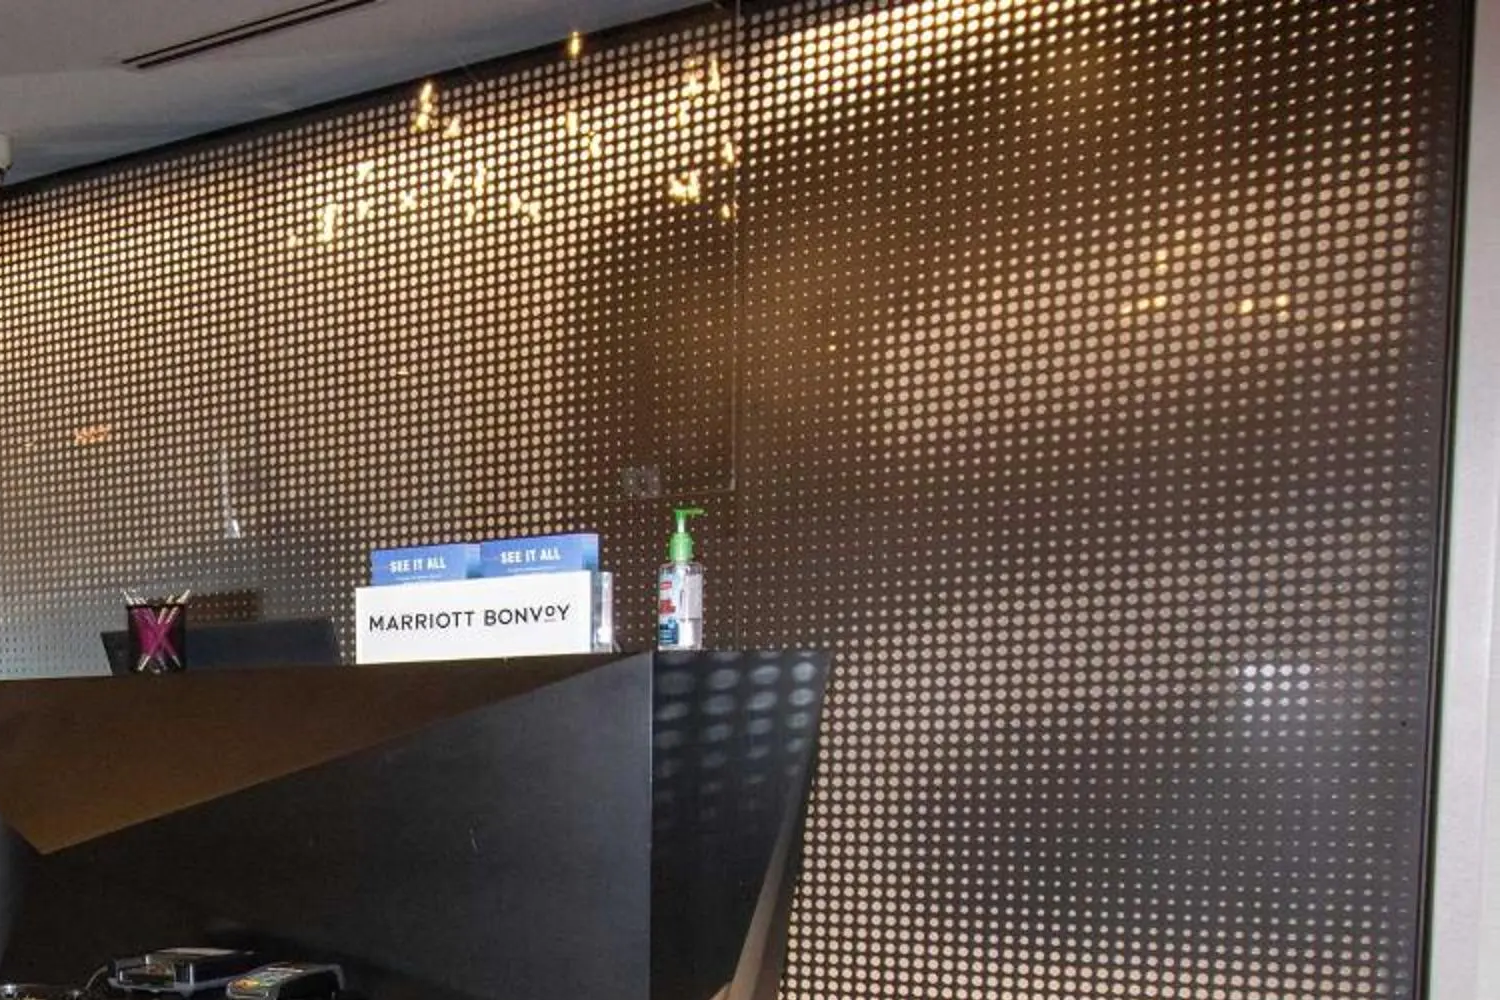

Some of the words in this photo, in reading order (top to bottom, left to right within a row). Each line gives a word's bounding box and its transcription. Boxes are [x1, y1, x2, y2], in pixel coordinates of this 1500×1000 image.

[500, 550, 522, 564] SEE
[525, 549, 536, 561] IT
[540, 547, 561, 561] ALL
[389, 559, 410, 573] SEE
[412, 558, 423, 571] IT
[426, 556, 446, 570] ALL
[369, 611, 475, 632] MARRIOTT
